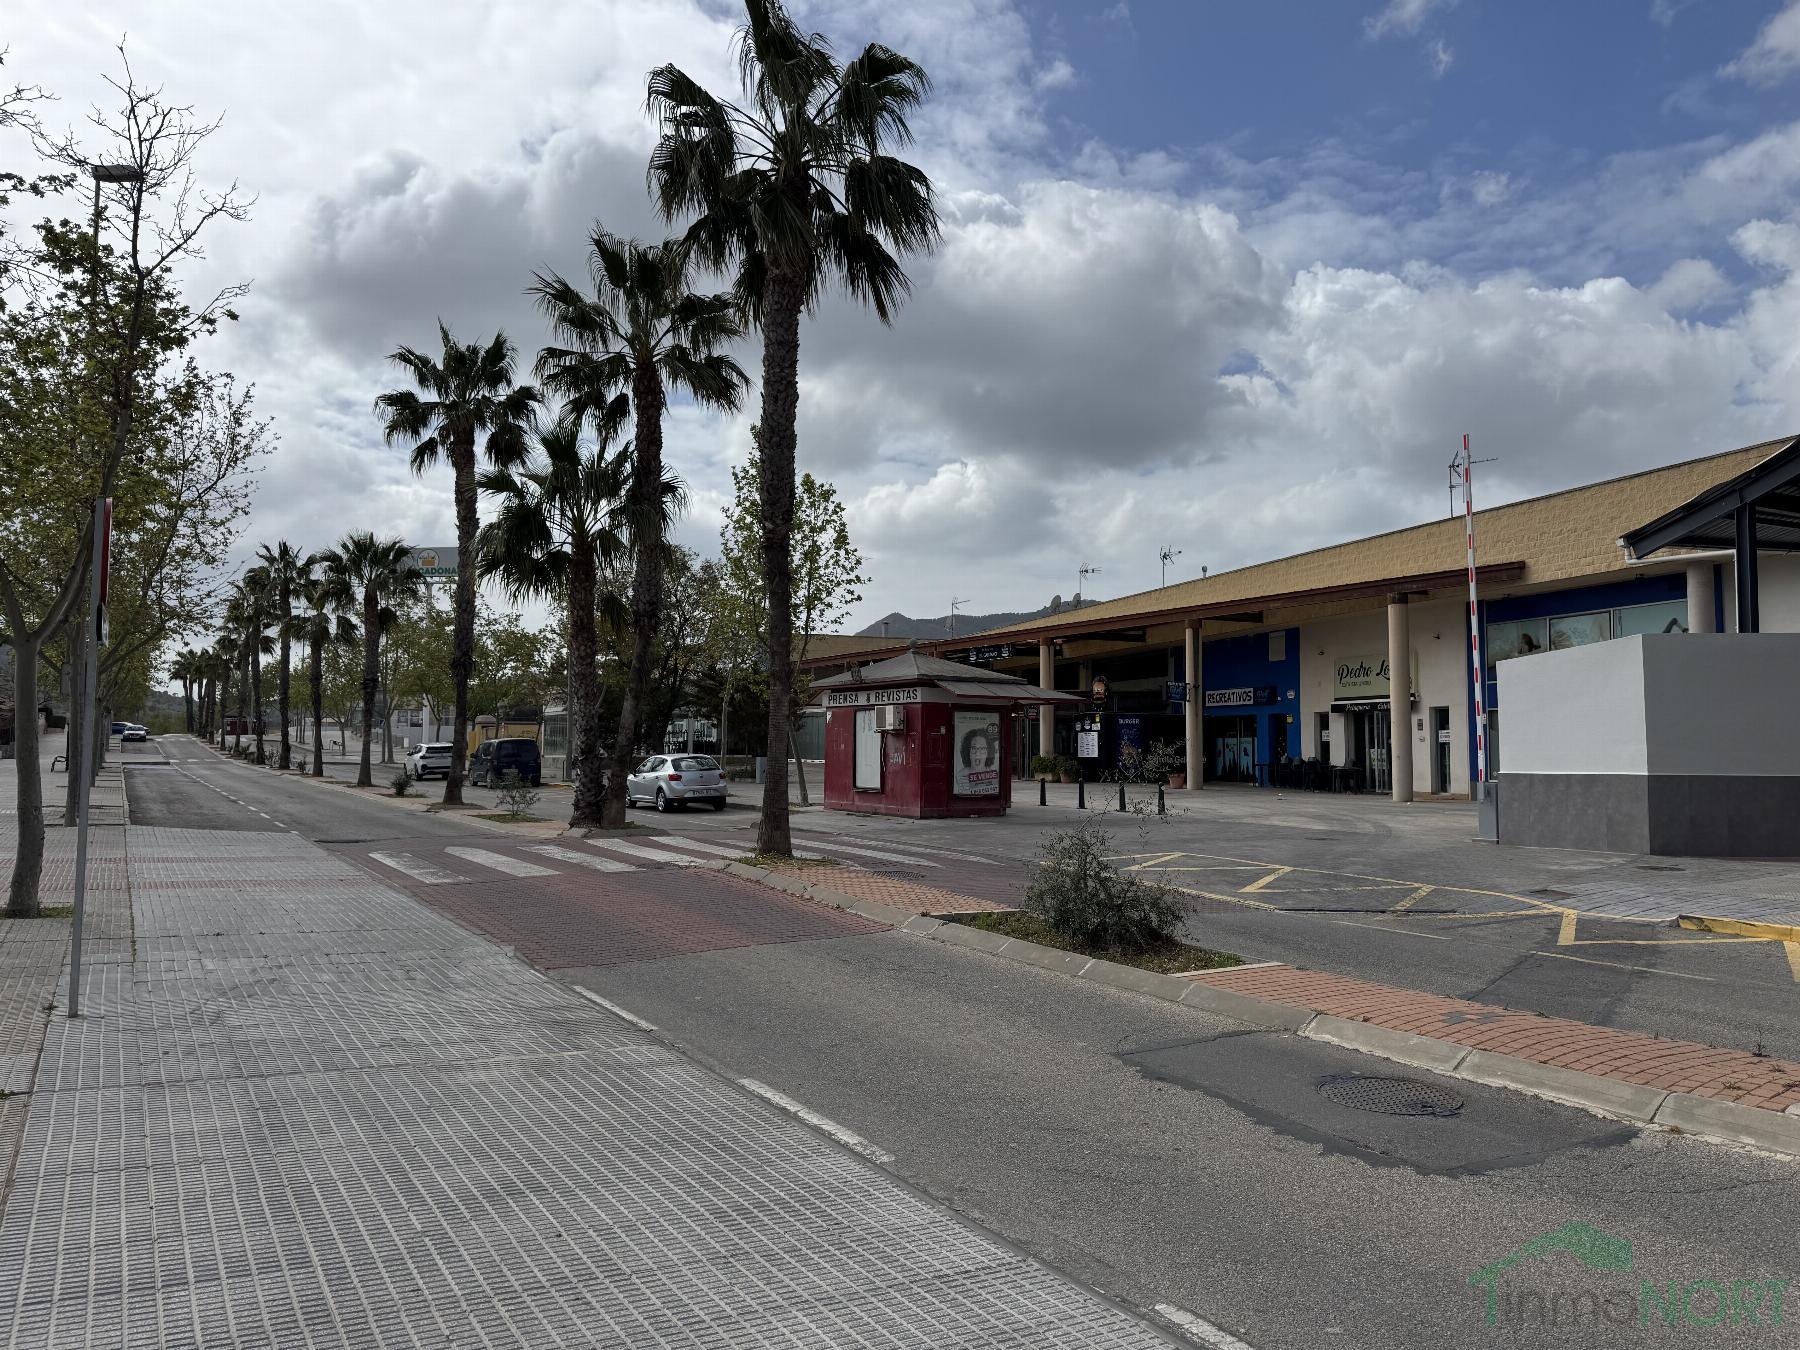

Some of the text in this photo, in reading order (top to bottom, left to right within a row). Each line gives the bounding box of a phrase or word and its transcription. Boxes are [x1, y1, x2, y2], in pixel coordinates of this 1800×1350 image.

[1337, 659, 1390, 685] Pedro Lo
[828, 693, 859, 705] PRENSA
[875, 688, 918, 703] REVISTAS
[1207, 690, 1252, 704] RECREATIVOS
[987, 725, 998, 734] 89
[969, 773, 977, 781] SE
